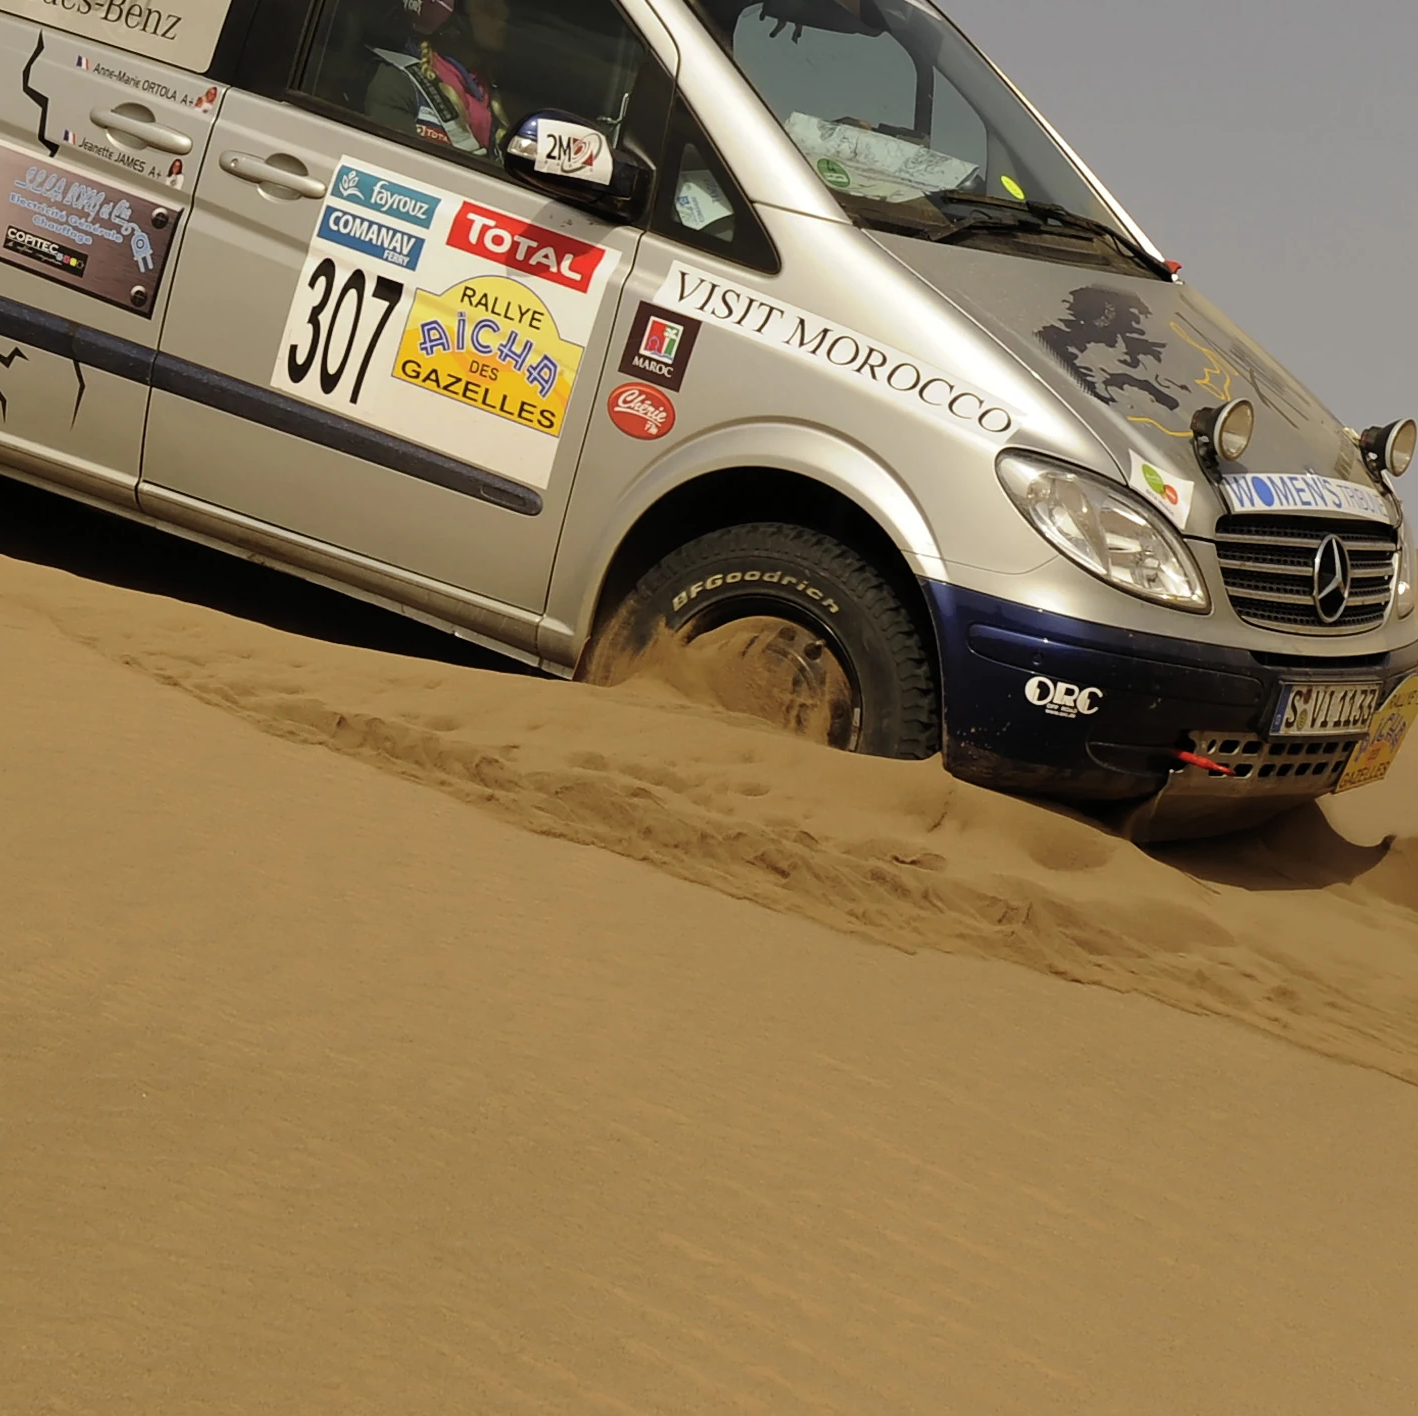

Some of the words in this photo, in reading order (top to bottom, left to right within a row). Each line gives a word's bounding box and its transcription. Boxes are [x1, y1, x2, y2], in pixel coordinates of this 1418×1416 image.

[92, 62, 141, 90] Anne-Marie
[141, 79, 178, 103] ORTOLA
[180, 93, 194, 107] A+
[78, 137, 115, 161] Jeanette
[114, 148, 147, 173] JAMES
[148, 165, 163, 179] A+
[546, 133, 572, 163] 2M
[10, 192, 67, 222] Electricité
[369, 180, 431, 220] fayrouz
[6, 227, 60, 254] COPITEC
[32, 214, 93, 245] Chauffage
[328, 210, 417, 256] COMANAV
[465, 212, 582, 282] TOTAL
[382, 248, 411, 268] FERRY
[459, 285, 545, 331] RALLYE
[286, 256, 405, 405] 307
[468, 359, 500, 382] DES
[631, 355, 675, 379] MAROC
[675, 269, 786, 335] VISIT
[782, 314, 1014, 434] MOROCCO
[401, 358, 558, 430] GAZELLES
[615, 388, 668, 425] Chérie
[671, 569, 841, 615] BFGoodrich
[1023, 675, 1104, 715] ORC
[1284, 689, 1304, 729] S
